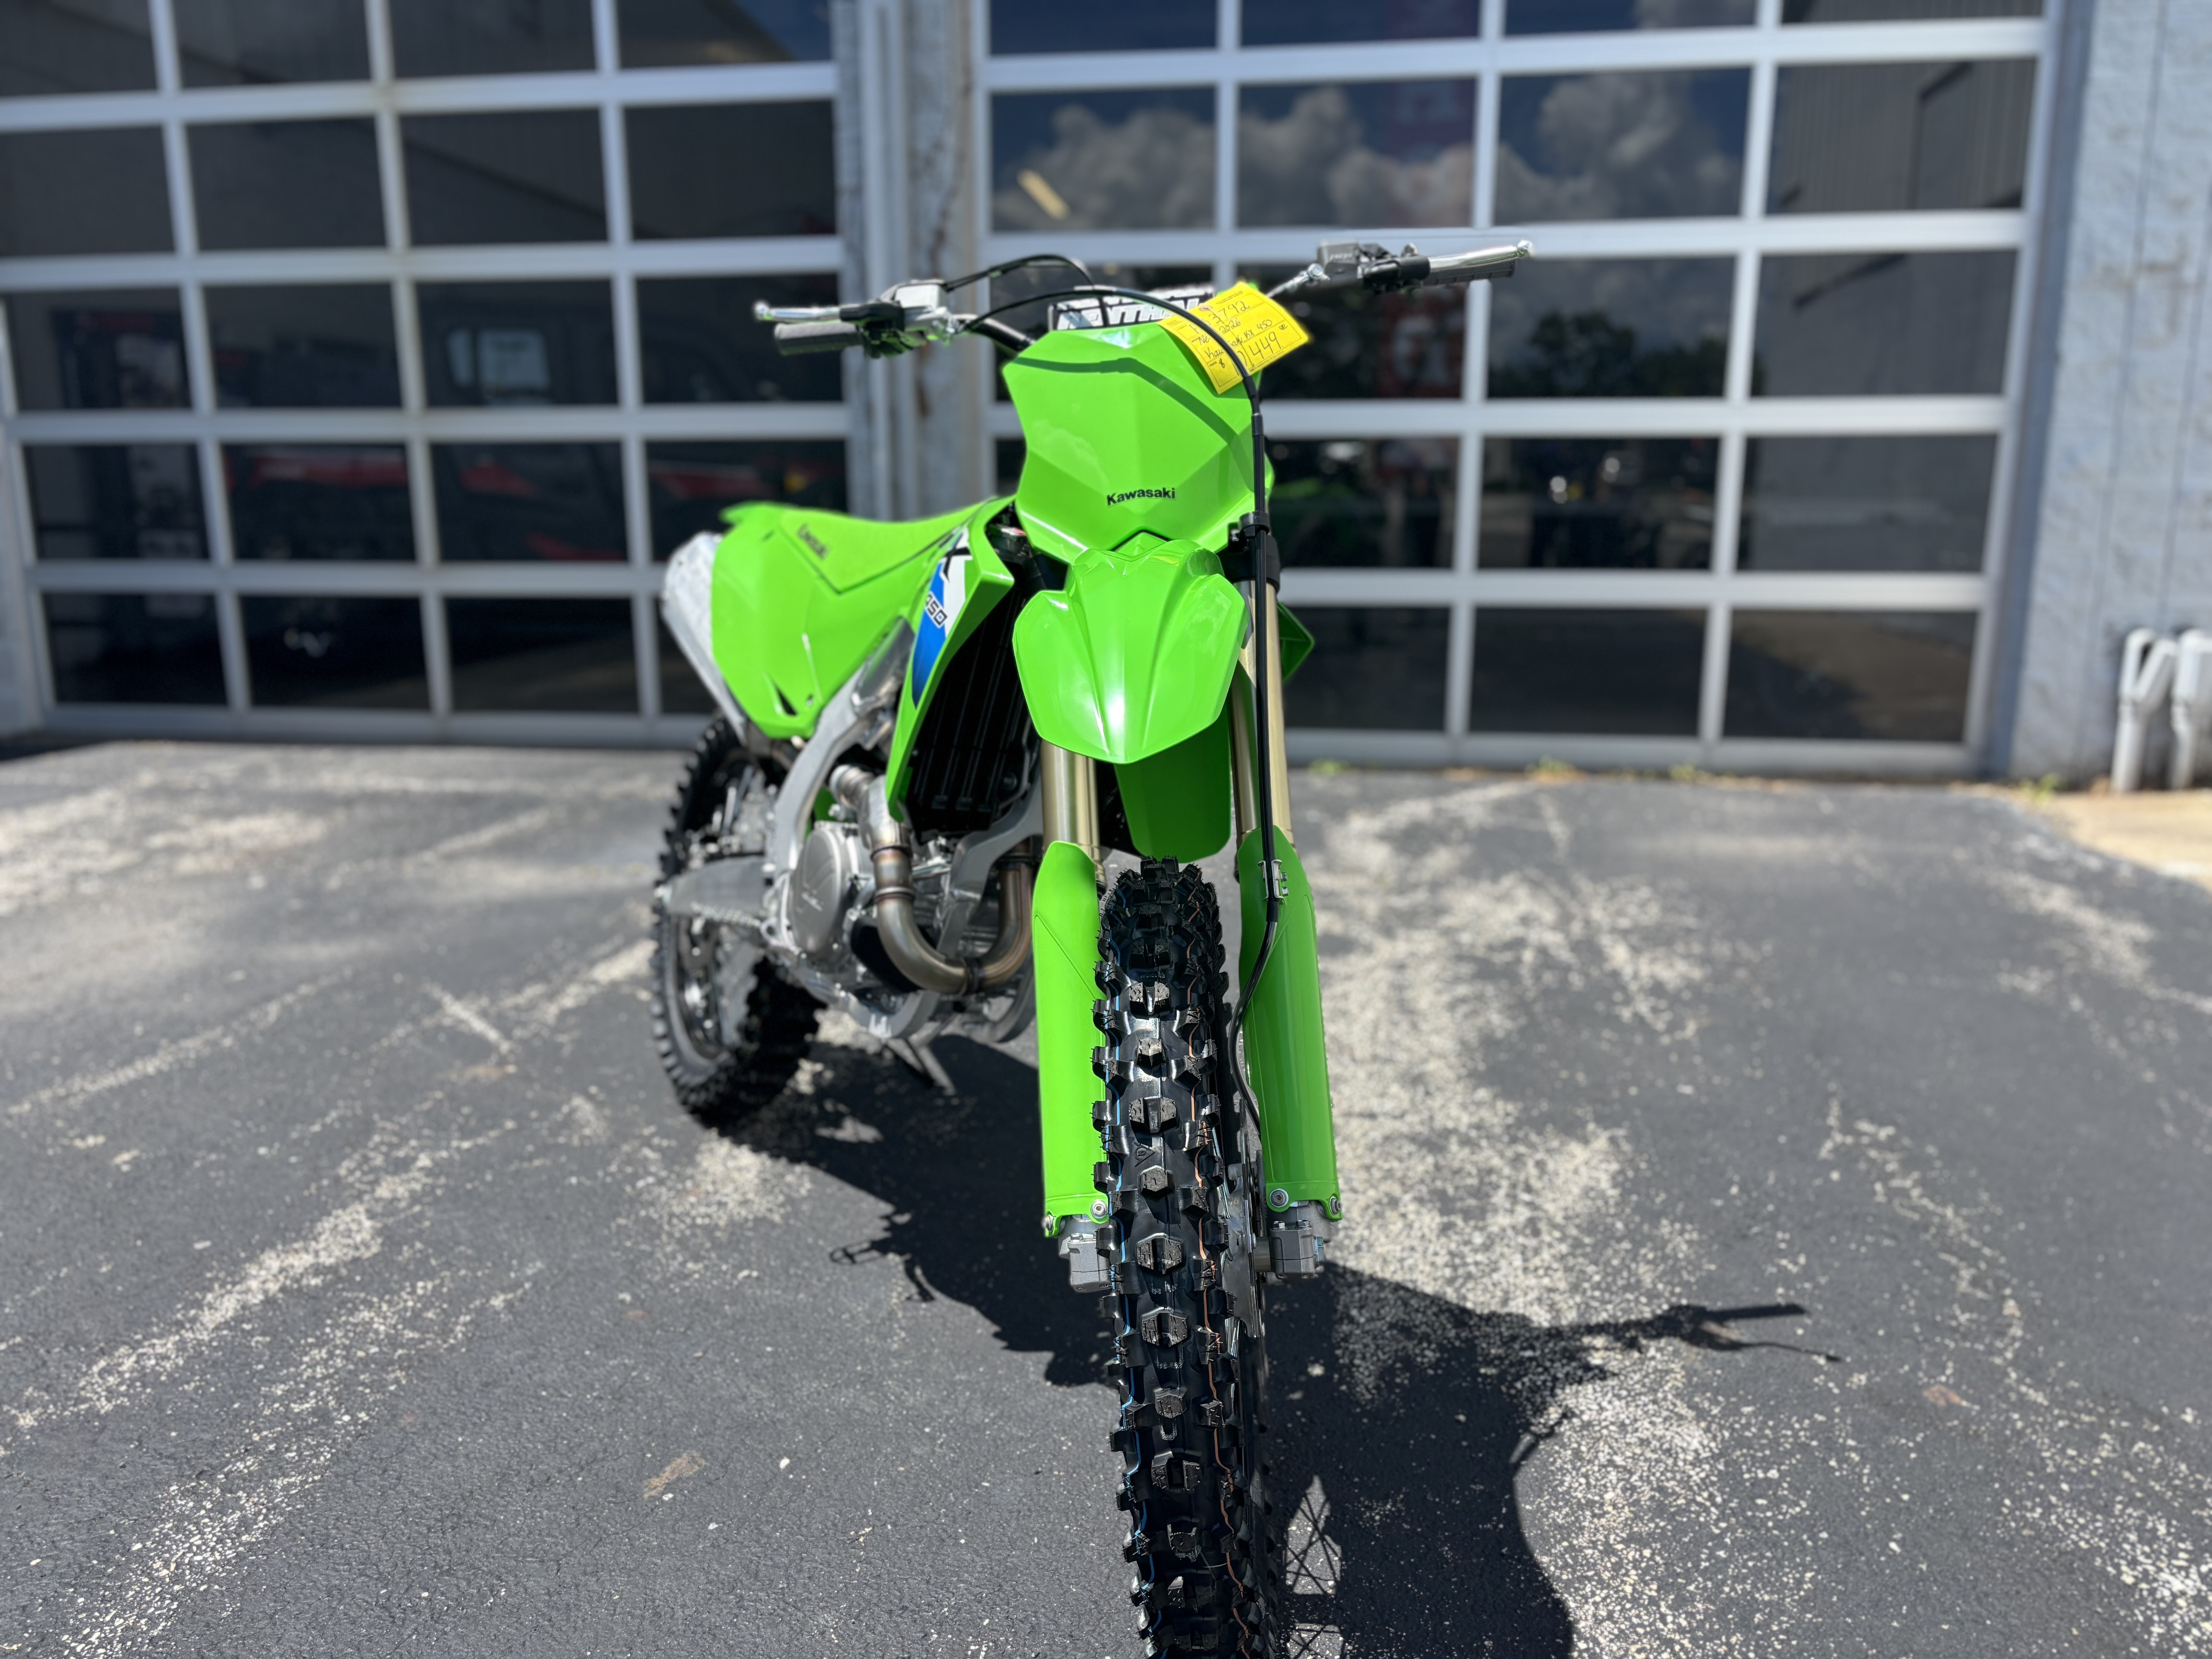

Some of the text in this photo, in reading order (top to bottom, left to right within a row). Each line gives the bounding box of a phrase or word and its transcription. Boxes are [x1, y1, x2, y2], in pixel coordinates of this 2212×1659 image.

[1219, 318, 1241, 334] 2026
[1257, 319, 1272, 330] 450
[1107, 487, 1176, 506] Kawasaki
